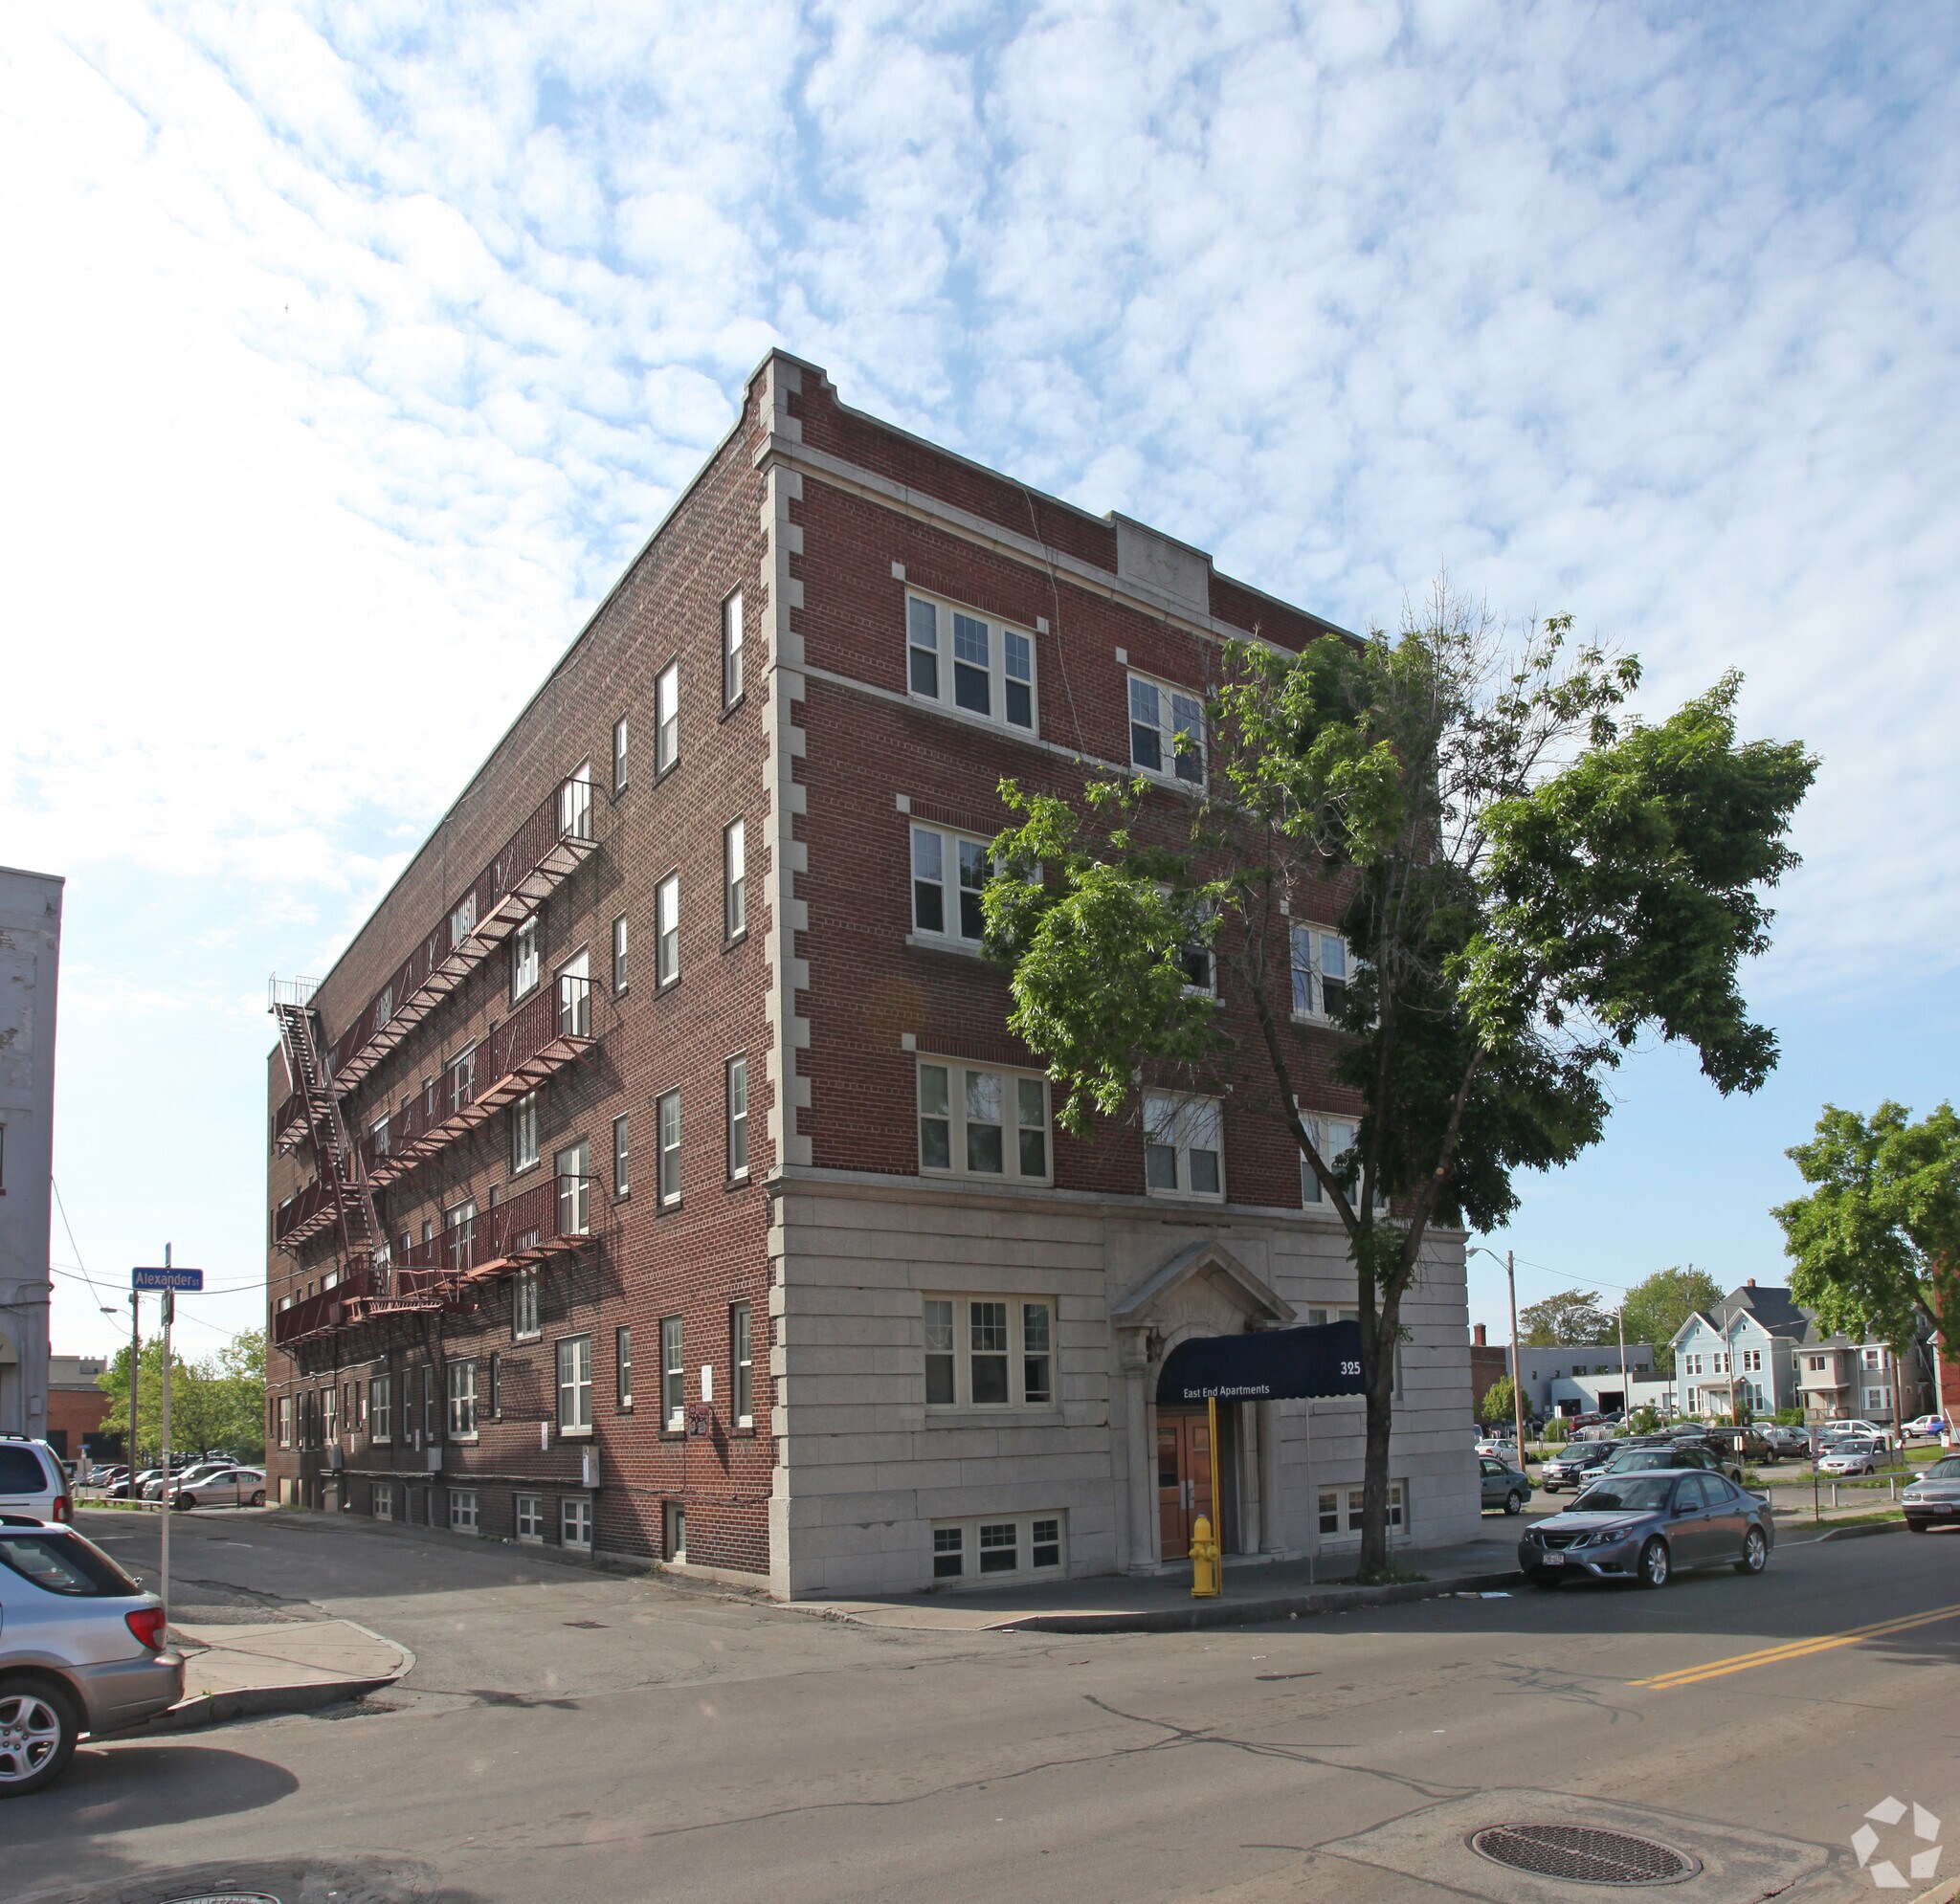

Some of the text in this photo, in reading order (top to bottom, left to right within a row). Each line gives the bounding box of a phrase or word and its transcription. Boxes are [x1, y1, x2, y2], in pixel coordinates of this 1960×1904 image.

[136, 1272, 192, 1286] Alexander
[1340, 1361, 1361, 1375] 325
[1184, 1384, 1270, 1399] East End Apartments
